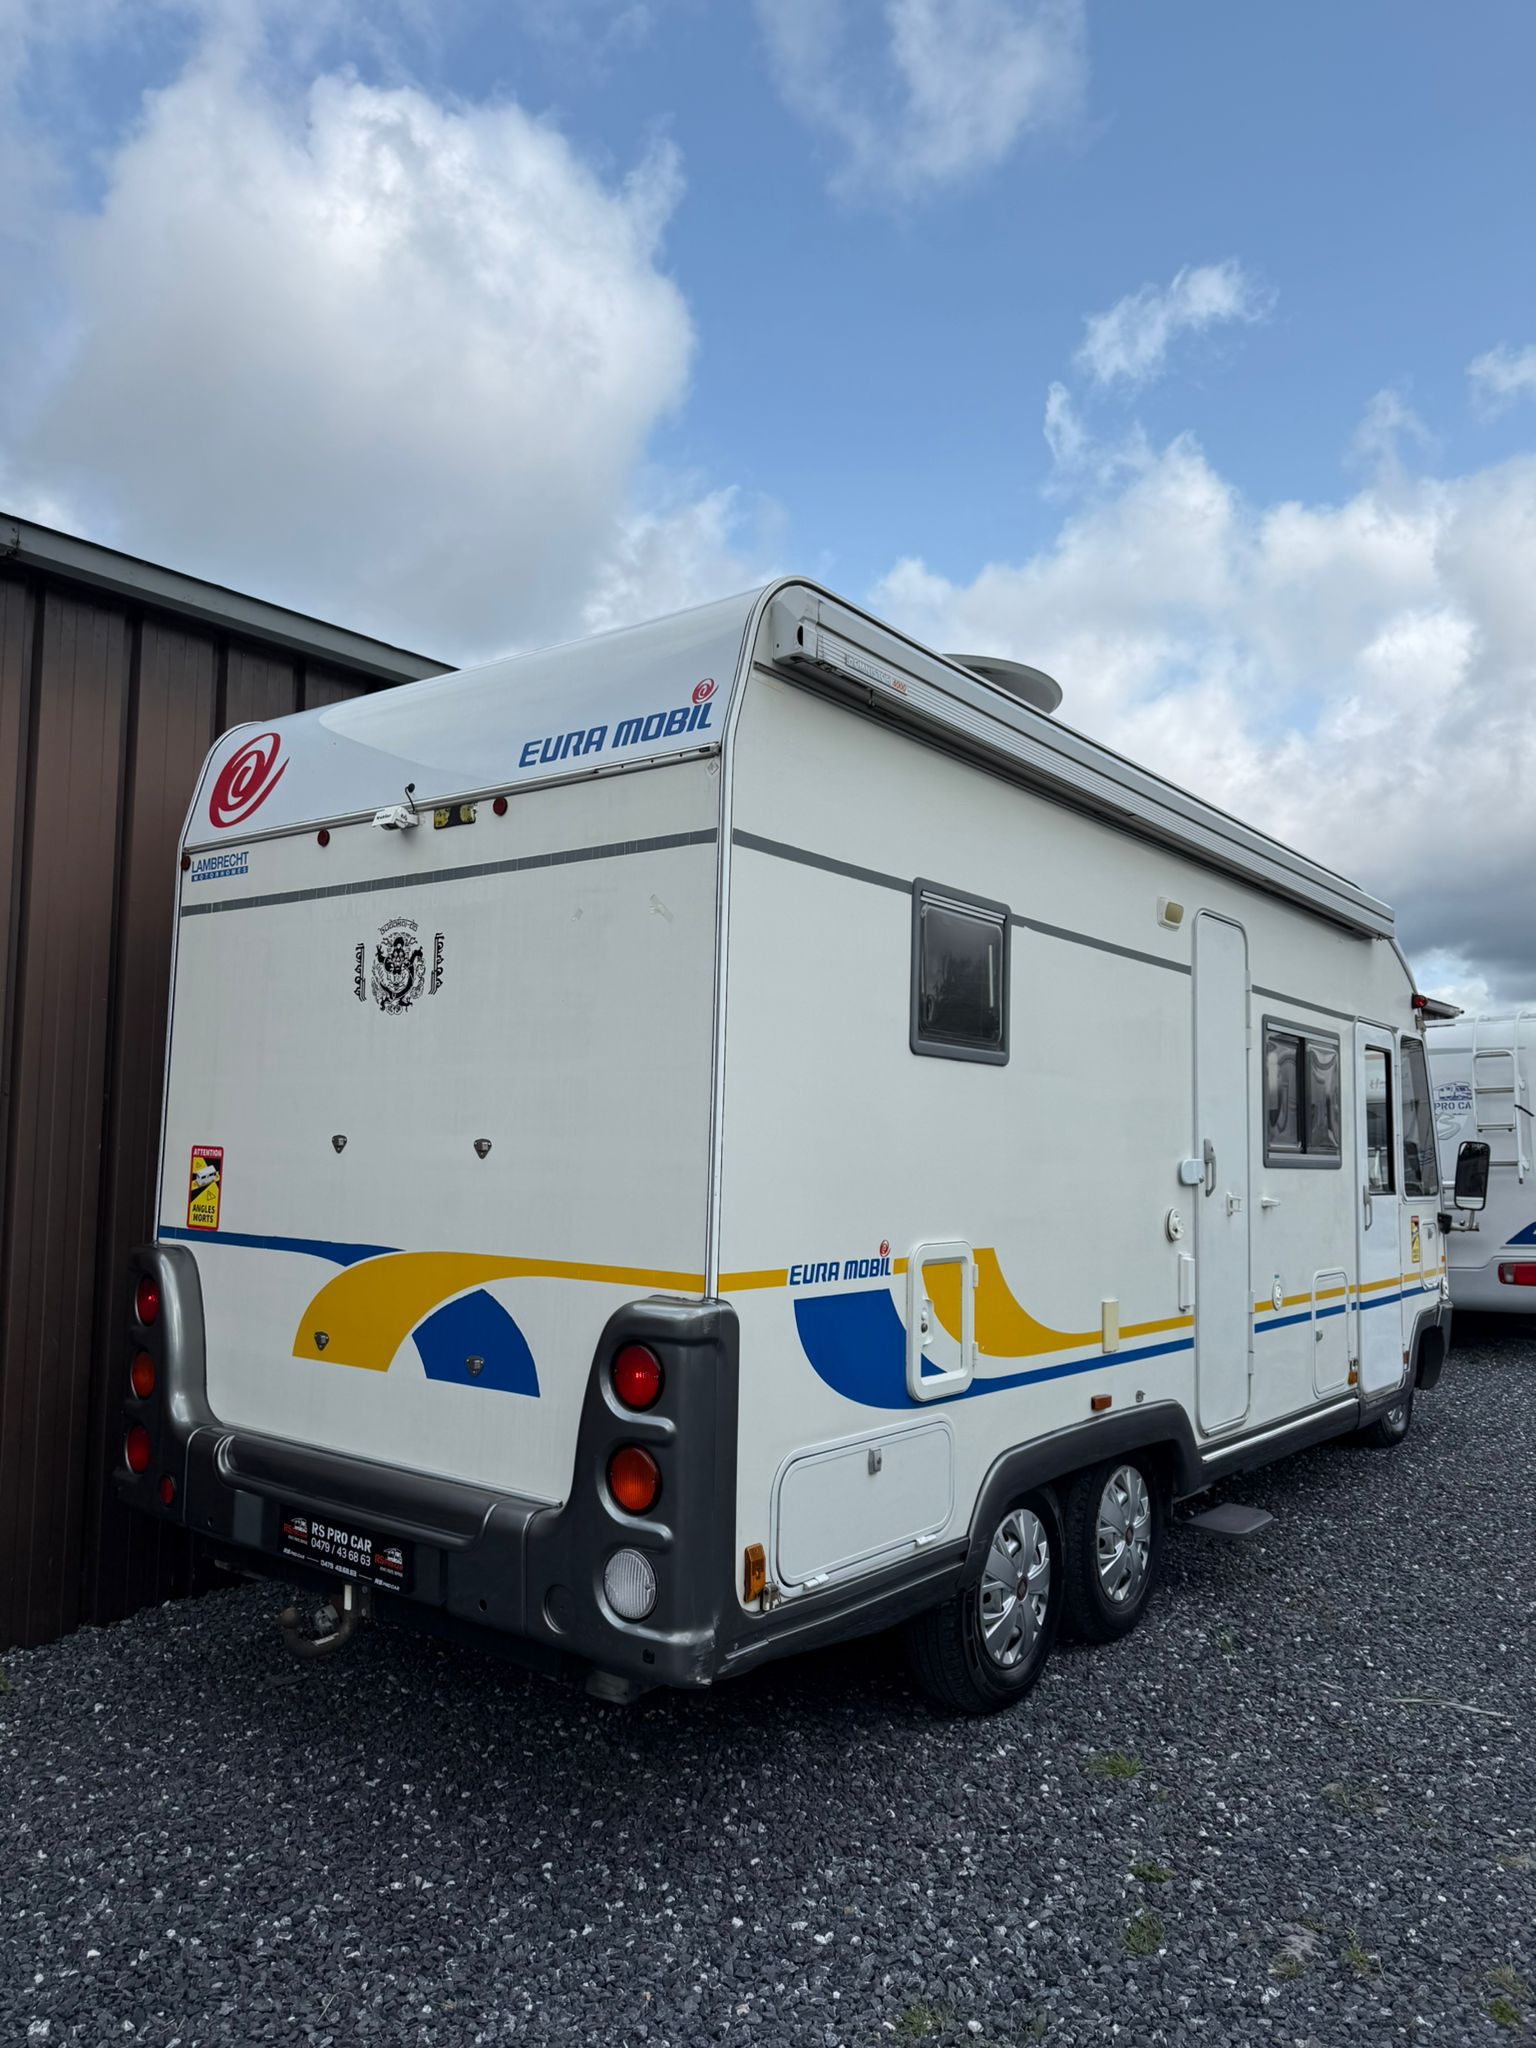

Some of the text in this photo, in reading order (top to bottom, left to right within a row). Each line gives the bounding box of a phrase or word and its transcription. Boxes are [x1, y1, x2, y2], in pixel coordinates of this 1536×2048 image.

[518, 702, 713, 768] EURA MOBIL
[191, 851, 249, 873] LAMBRECHT
[193, 867, 247, 881] MOTORHOMES
[1434, 1101, 1472, 1110] PRO CA
[192, 1204, 215, 1214] ANGLES
[192, 1213, 214, 1223] MORTS
[789, 1257, 891, 1286] EURA MOBIL
[311, 1521, 325, 1538] RS
[326, 1526, 348, 1545] PRO
[350, 1535, 372, 1553] CAR
[310, 1537, 330, 1553] 0479
[336, 1548, 347, 1559] 43
[348, 1551, 359, 1562] 68
[360, 1554, 371, 1567] 63
